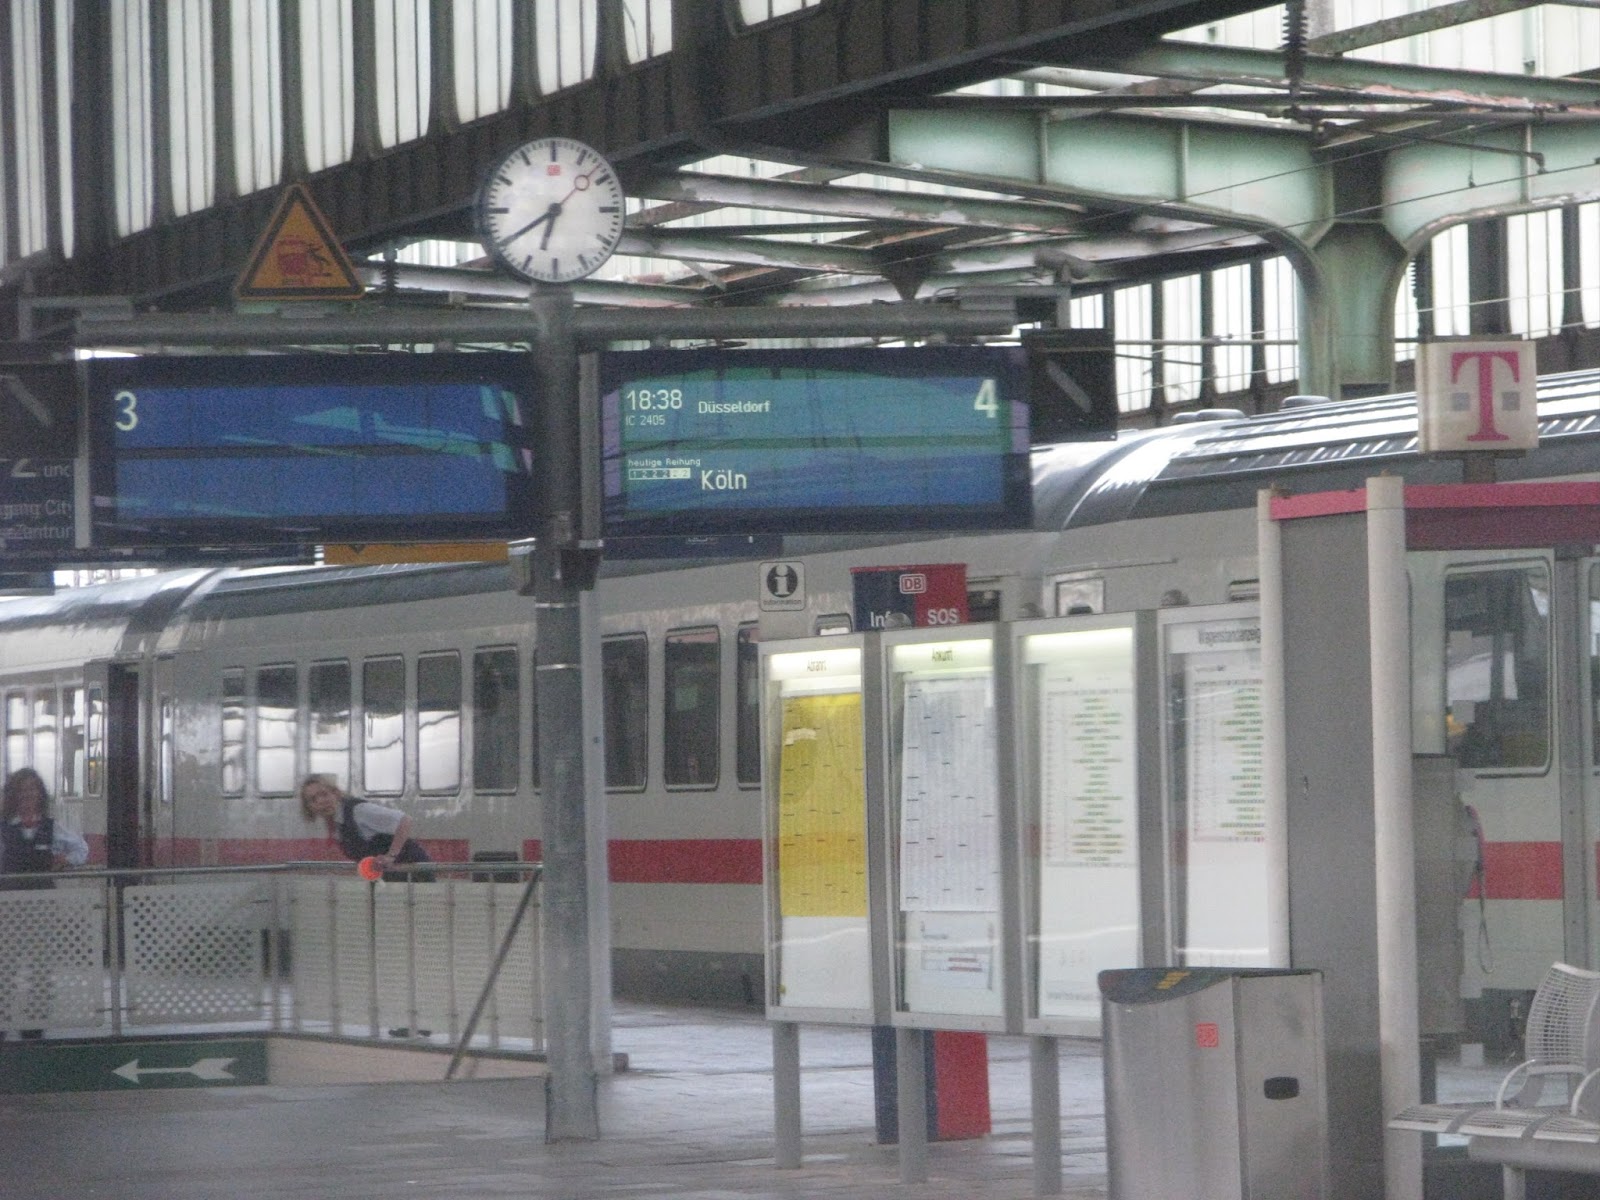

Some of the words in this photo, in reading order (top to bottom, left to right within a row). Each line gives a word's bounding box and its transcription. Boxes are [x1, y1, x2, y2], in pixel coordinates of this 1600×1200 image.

[626, 389, 683, 410] 18:38
[974, 379, 998, 418] 4
[1452, 351, 1520, 442] T
[114, 391, 138, 431] 3
[698, 400, 771, 414] Düsseldorf
[625, 416, 635, 426] IC
[640, 414, 666, 426] 2405
[628, 458, 662, 467] heutige
[665, 457, 701, 467] Reihung
[701, 469, 748, 490] Köln
[902, 576, 924, 592] DB
[870, 610, 892, 628] Inf
[927, 608, 959, 625] SOS
